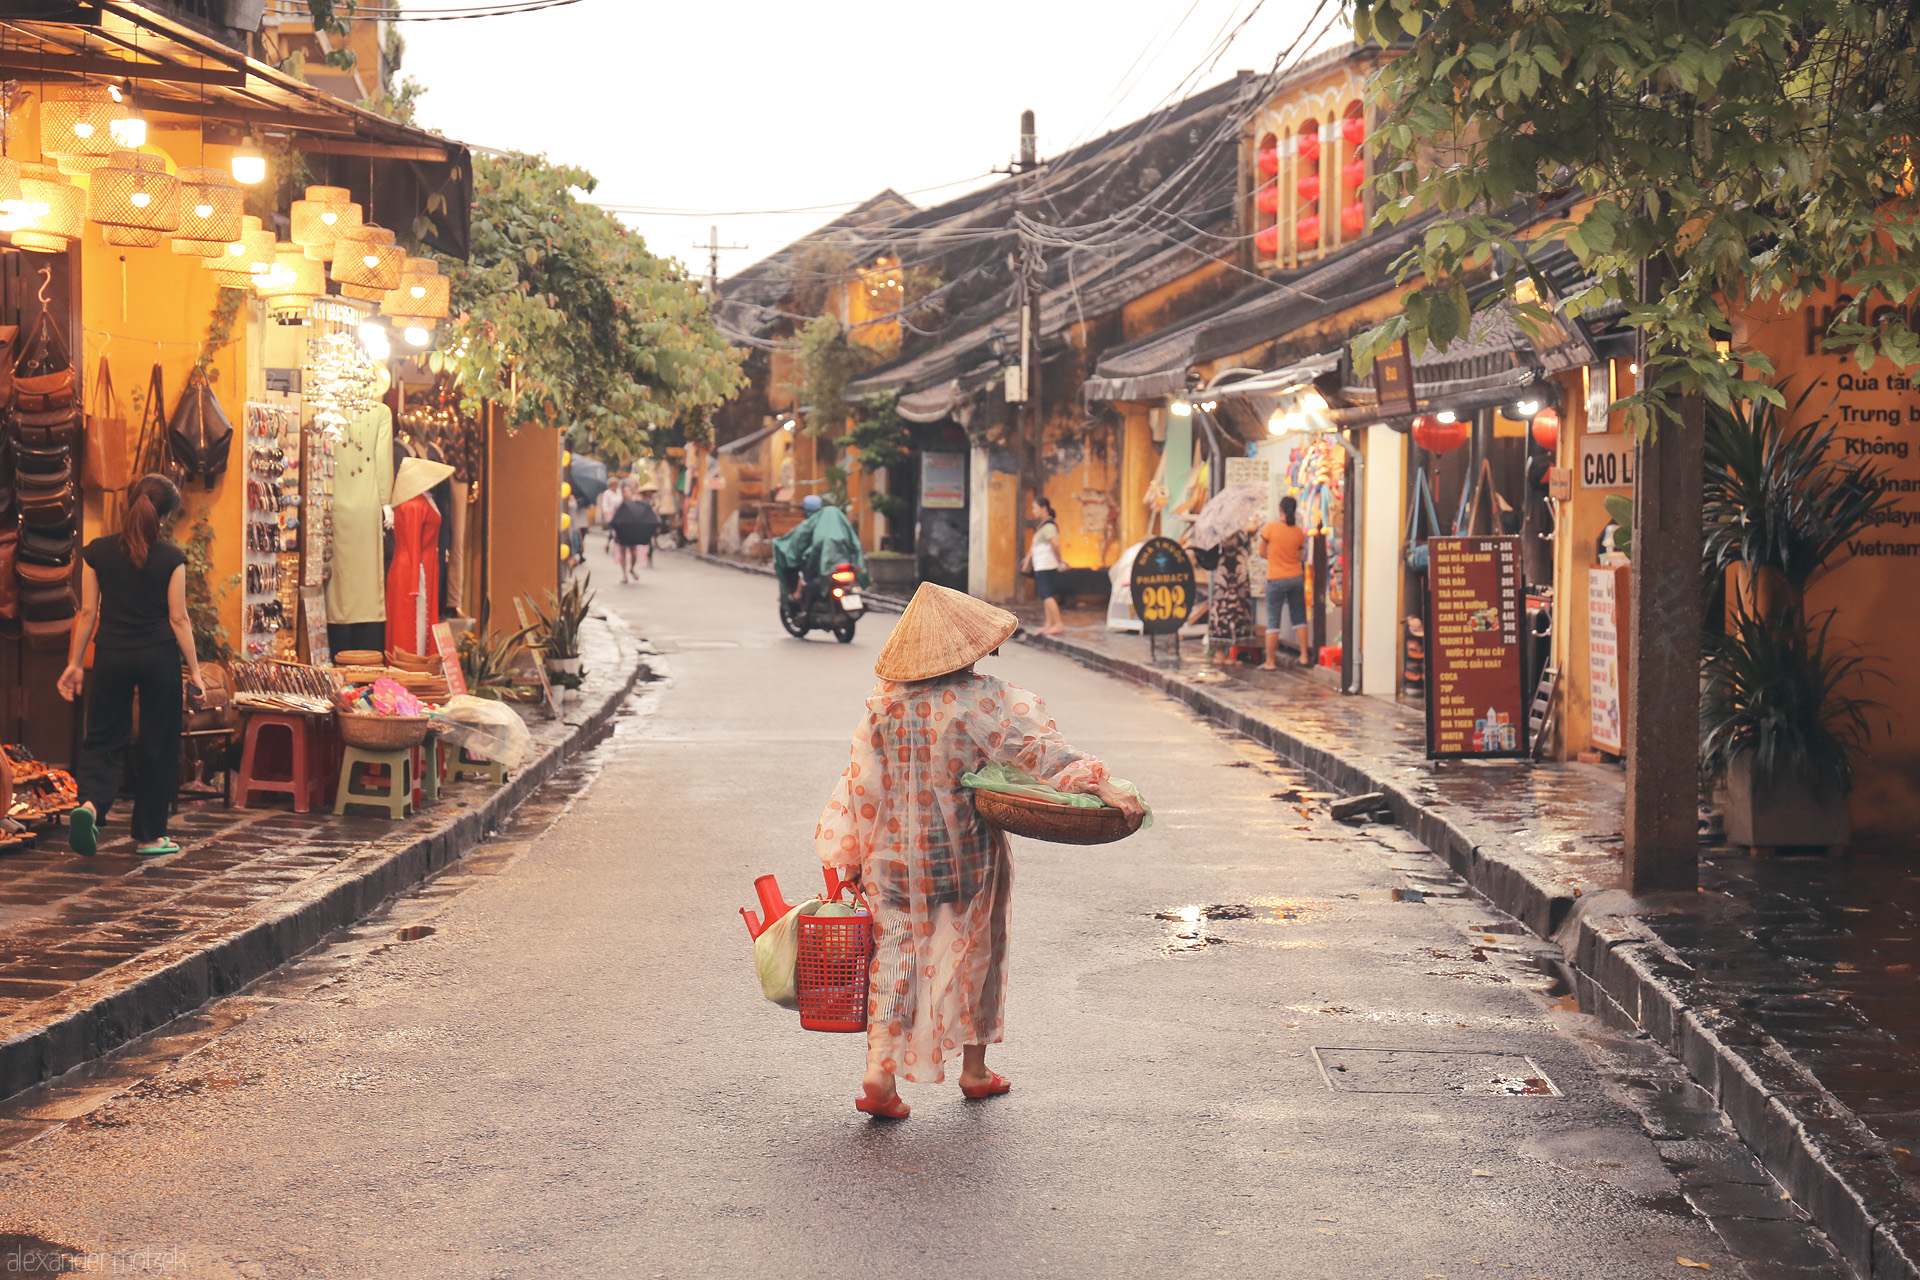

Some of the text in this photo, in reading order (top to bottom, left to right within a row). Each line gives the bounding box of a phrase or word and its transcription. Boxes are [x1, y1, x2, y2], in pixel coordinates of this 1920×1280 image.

[1839, 405, 1900, 426] Trưng
[1845, 436, 1909, 459] Không
[1584, 452, 1634, 485] CAO L
[1136, 573, 1190, 585] PHARMACY
[1142, 584, 1188, 621] 292
[1440, 672, 1458, 681] COCA
